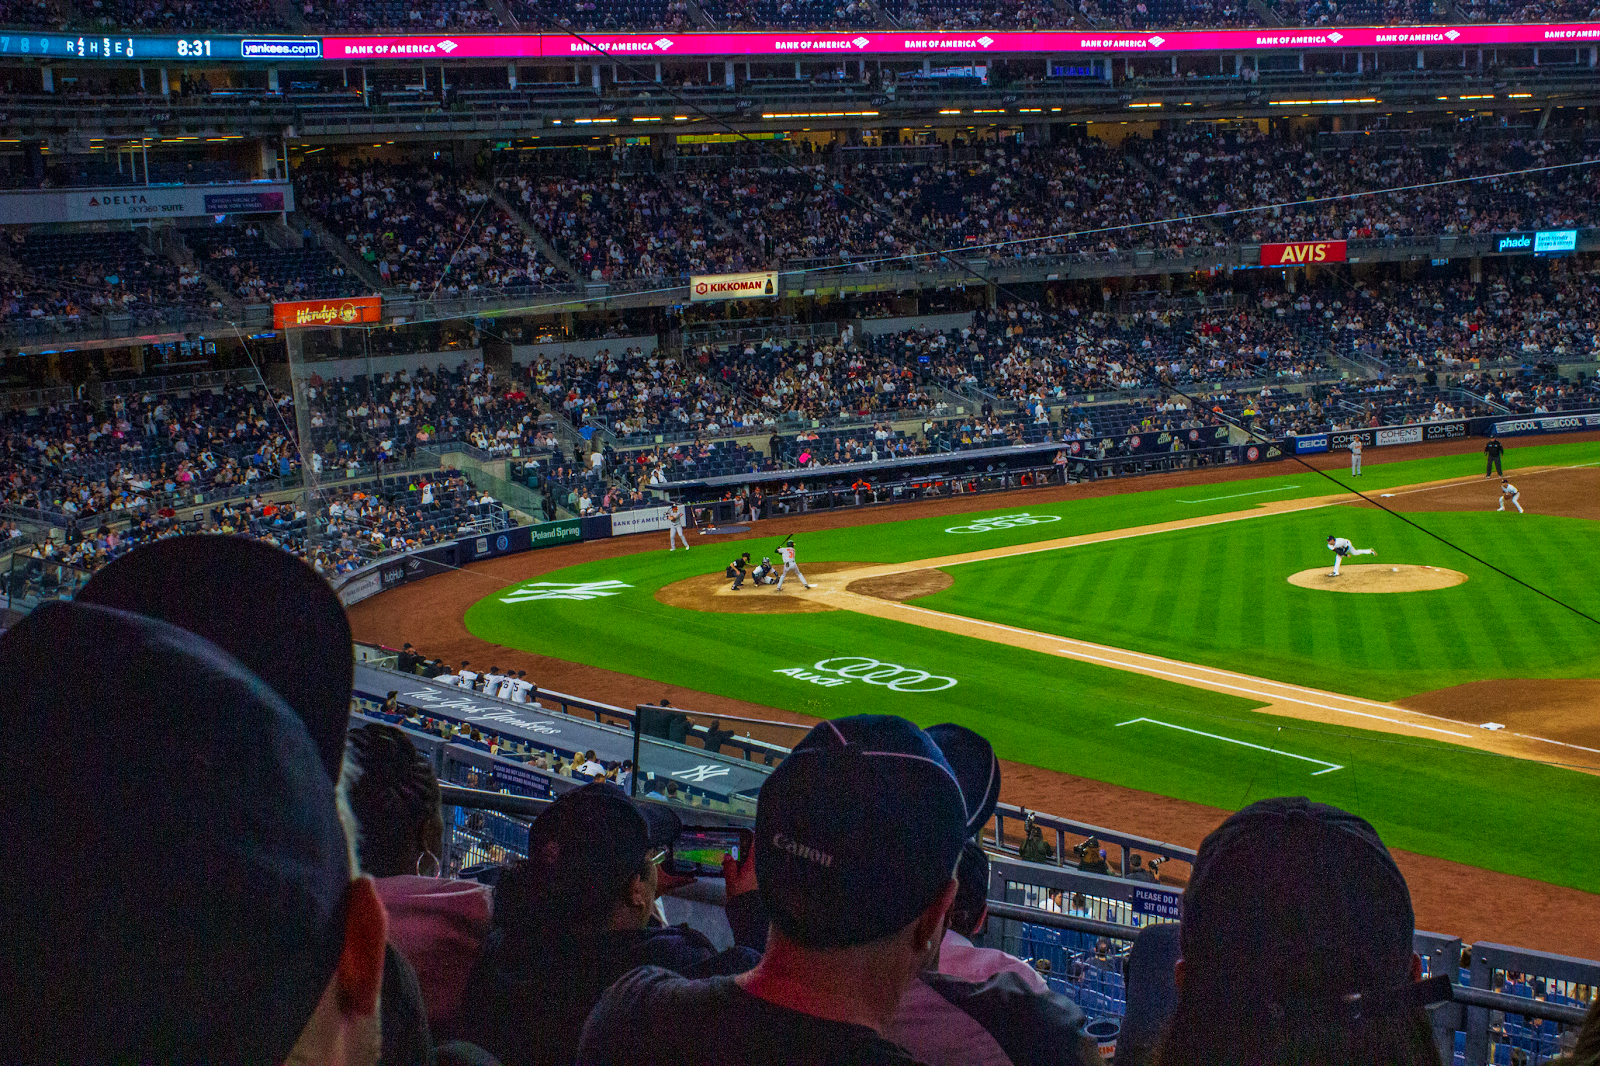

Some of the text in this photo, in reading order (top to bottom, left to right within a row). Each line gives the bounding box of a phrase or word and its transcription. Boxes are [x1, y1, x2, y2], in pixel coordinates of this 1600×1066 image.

[1376, 33, 1443, 42] BANK OF AMERICA
[1544, 31, 1565, 39] BANK
[1566, 30, 1576, 38] OF
[1, 37, 49, 53] 7 8 9
[77, 37, 85, 47] 4
[103, 38, 110, 47] 5
[127, 38, 133, 47] 1
[775, 41, 851, 50] BANK OF AMERICA
[905, 40, 976, 48] BANK OF AMERICA
[1081, 40, 1146, 48] BANK OF AMERICA
[1256, 36, 1326, 45] BANK OF AMERICA
[66, 41, 75, 52] R
[90, 42, 98, 53] H
[114, 42, 122, 53] E
[177, 39, 211, 56] 8:31
[245, 43, 316, 55] yankees.com
[345, 45, 436, 54] BANK OF AMERICA
[598, 43, 611, 51] OF
[612, 42, 653, 51] AMERICA
[78, 47, 85, 57] 2
[103, 47, 111, 57] 3
[126, 47, 134, 57] 0
[103, 195, 147, 205] DELTA
[162, 204, 184, 212] SUITE
[1499, 235, 1531, 252] phade
[1280, 244, 1326, 262] AVIS
[710, 281, 762, 292] KIKKOMAN
[297, 305, 338, 324] Wendy's
[1514, 422, 1538, 431] COOL
[1560, 418, 1582, 427] COOL
[1381, 429, 1417, 438] COHEN'S
[1428, 424, 1464, 434] COHEN'S
[1298, 439, 1327, 448] GEICO
[531, 527, 579, 542] Poland Spring
[773, 668, 852, 687] Audi
[403, 687, 561, 734] New York Yankees
[1136, 890, 1162, 902] PLEASE
[1163, 895, 1173, 904] DO
[1144, 902, 1178, 915] SIT ON OR
